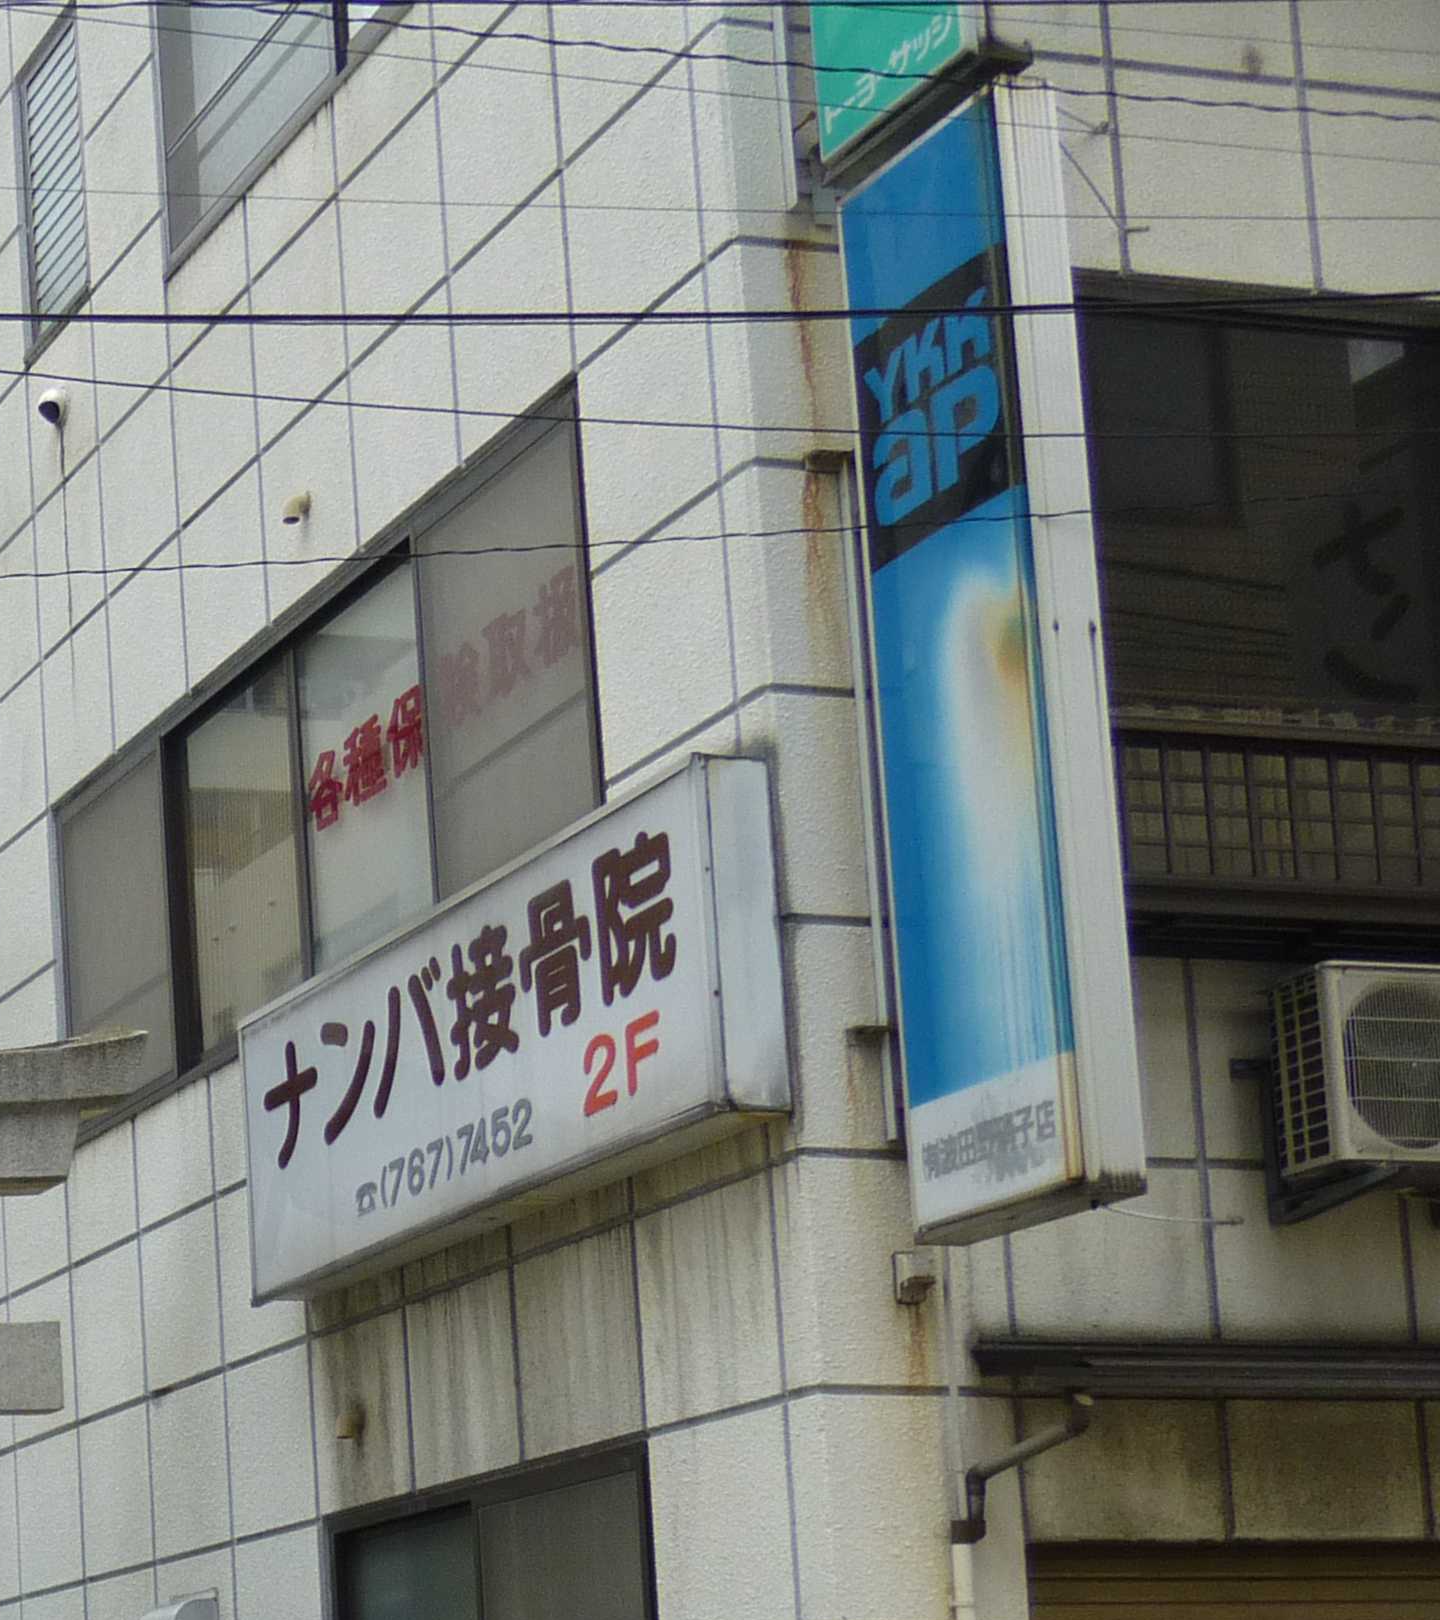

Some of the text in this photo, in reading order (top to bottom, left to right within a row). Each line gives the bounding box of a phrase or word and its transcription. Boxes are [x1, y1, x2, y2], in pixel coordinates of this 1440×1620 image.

[863, 285, 990, 424] YKK
[263, 830, 678, 1171] ナンバ接骨院
[582, 1008, 661, 1118] 2F
